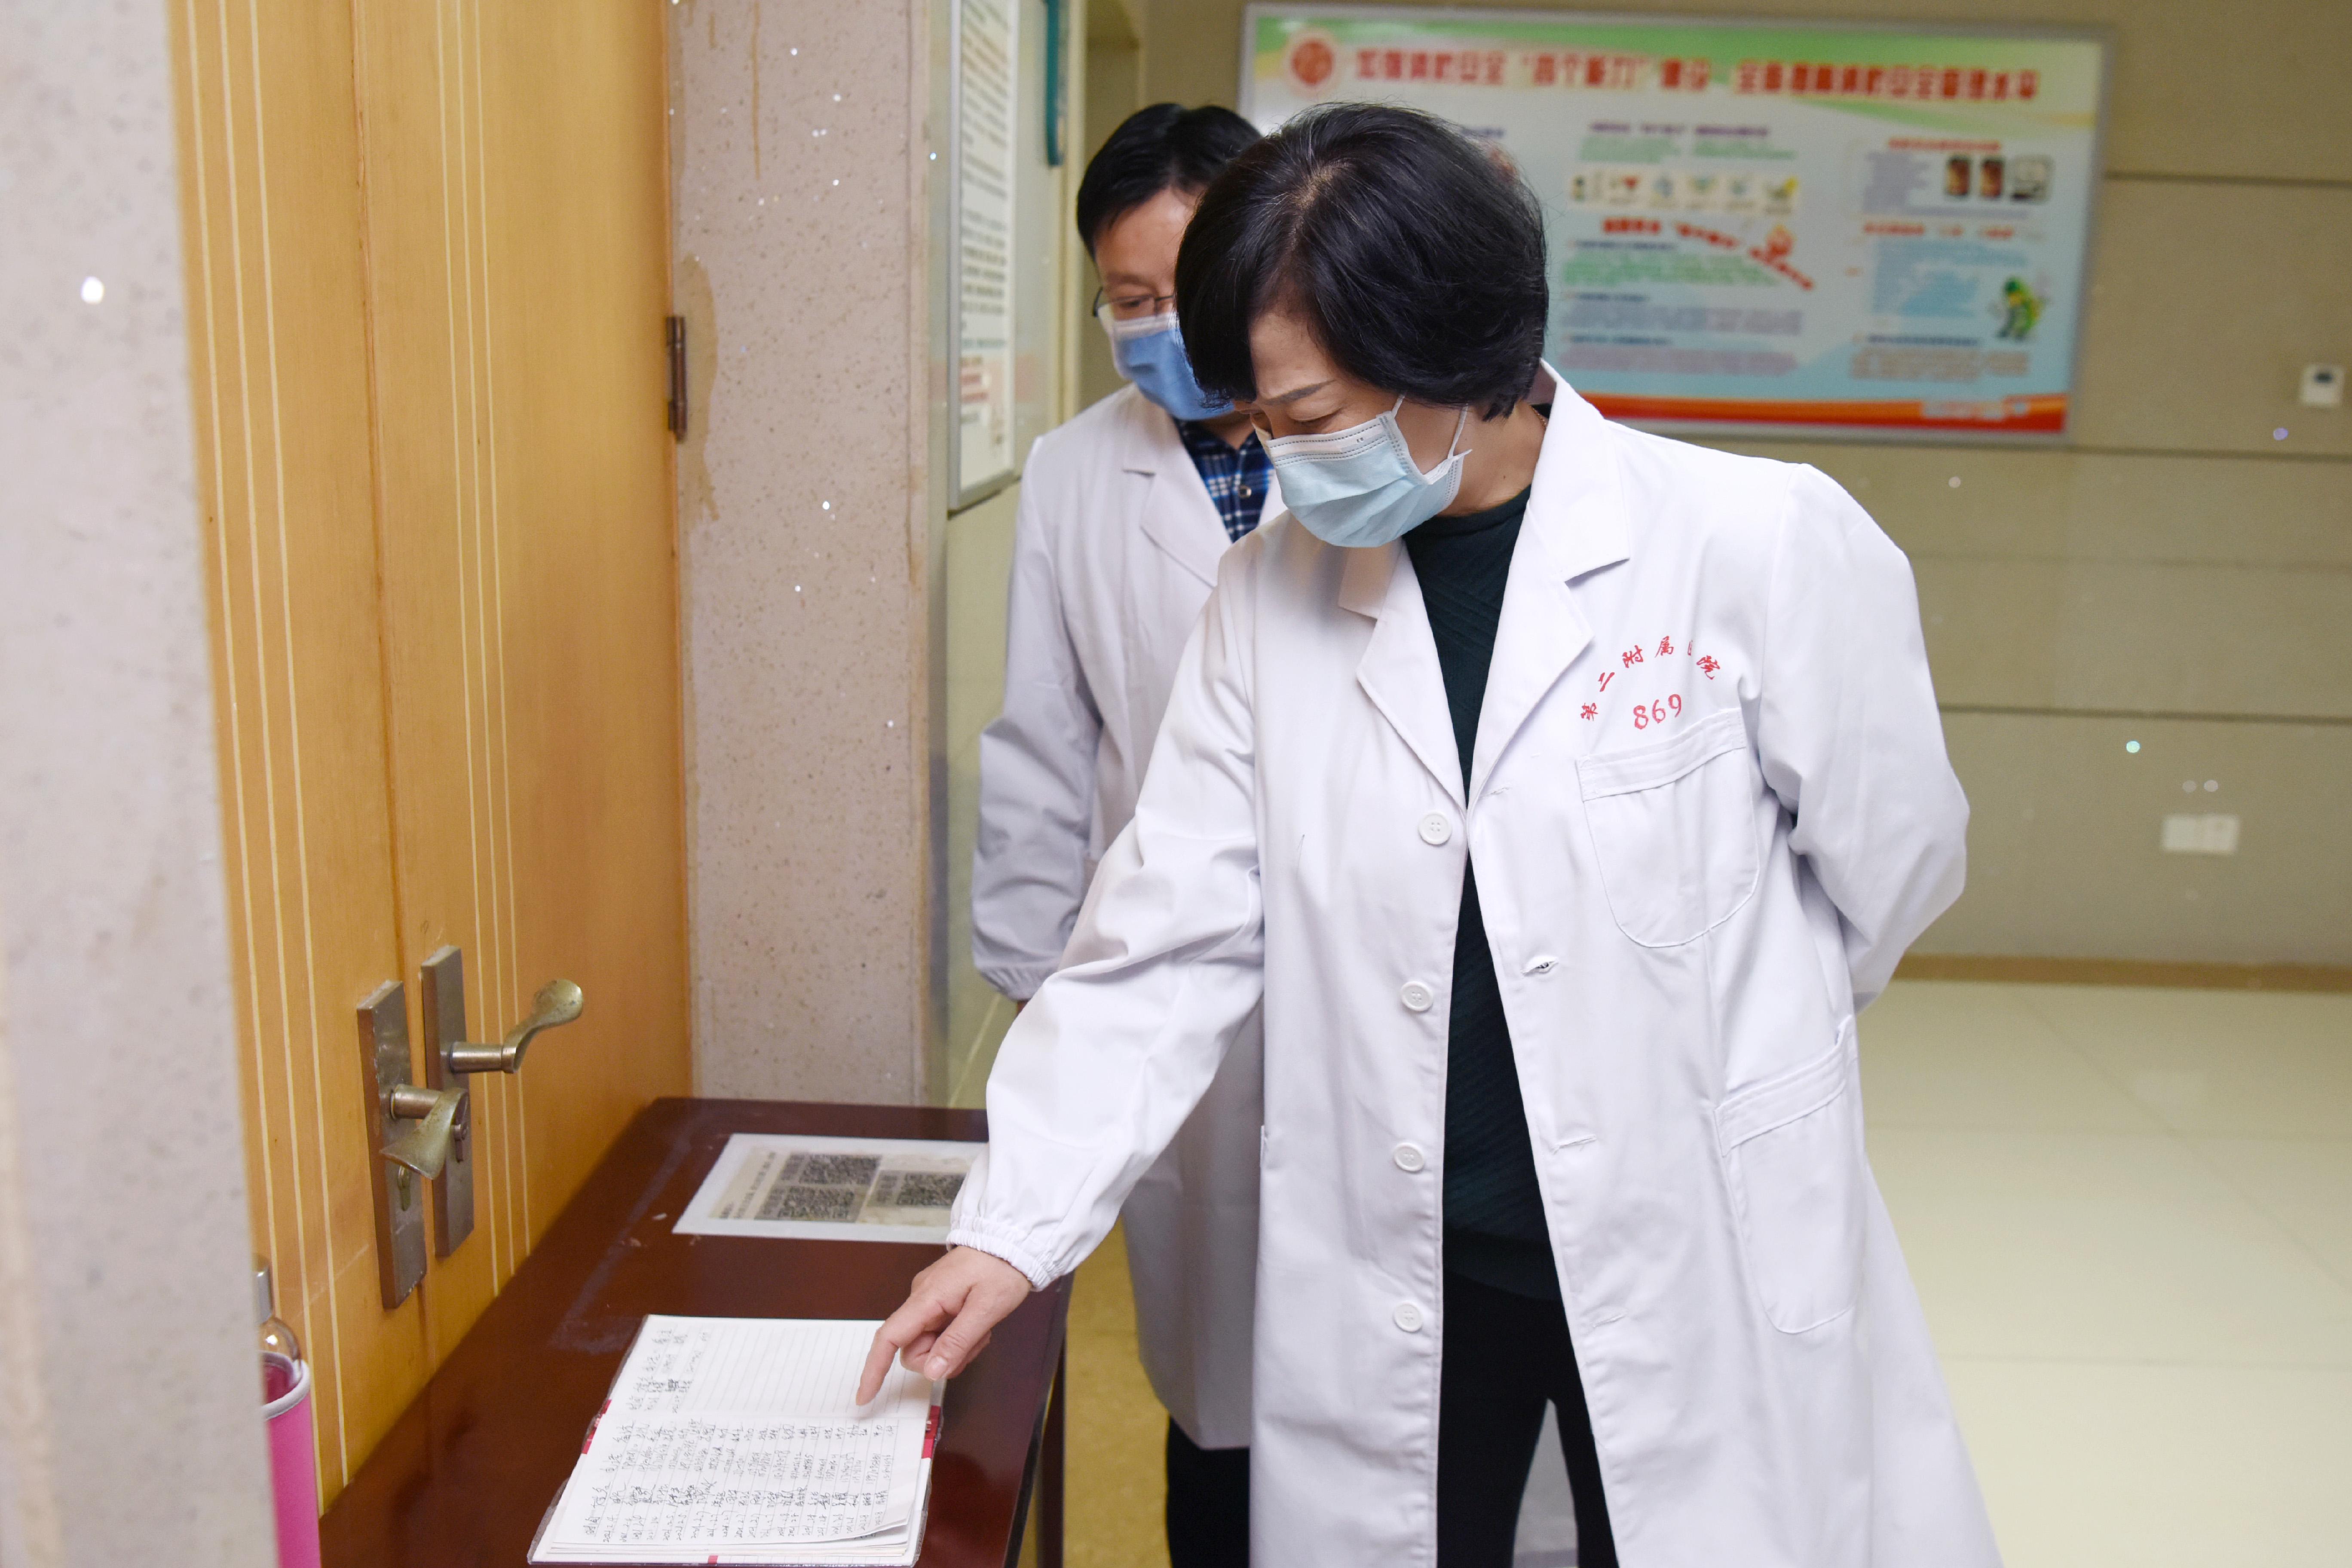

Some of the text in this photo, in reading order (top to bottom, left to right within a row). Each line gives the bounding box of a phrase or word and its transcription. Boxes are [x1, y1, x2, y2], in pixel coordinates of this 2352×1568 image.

[1581, 635, 1721, 720] 第二附属院
[1632, 694, 1682, 730] 869
